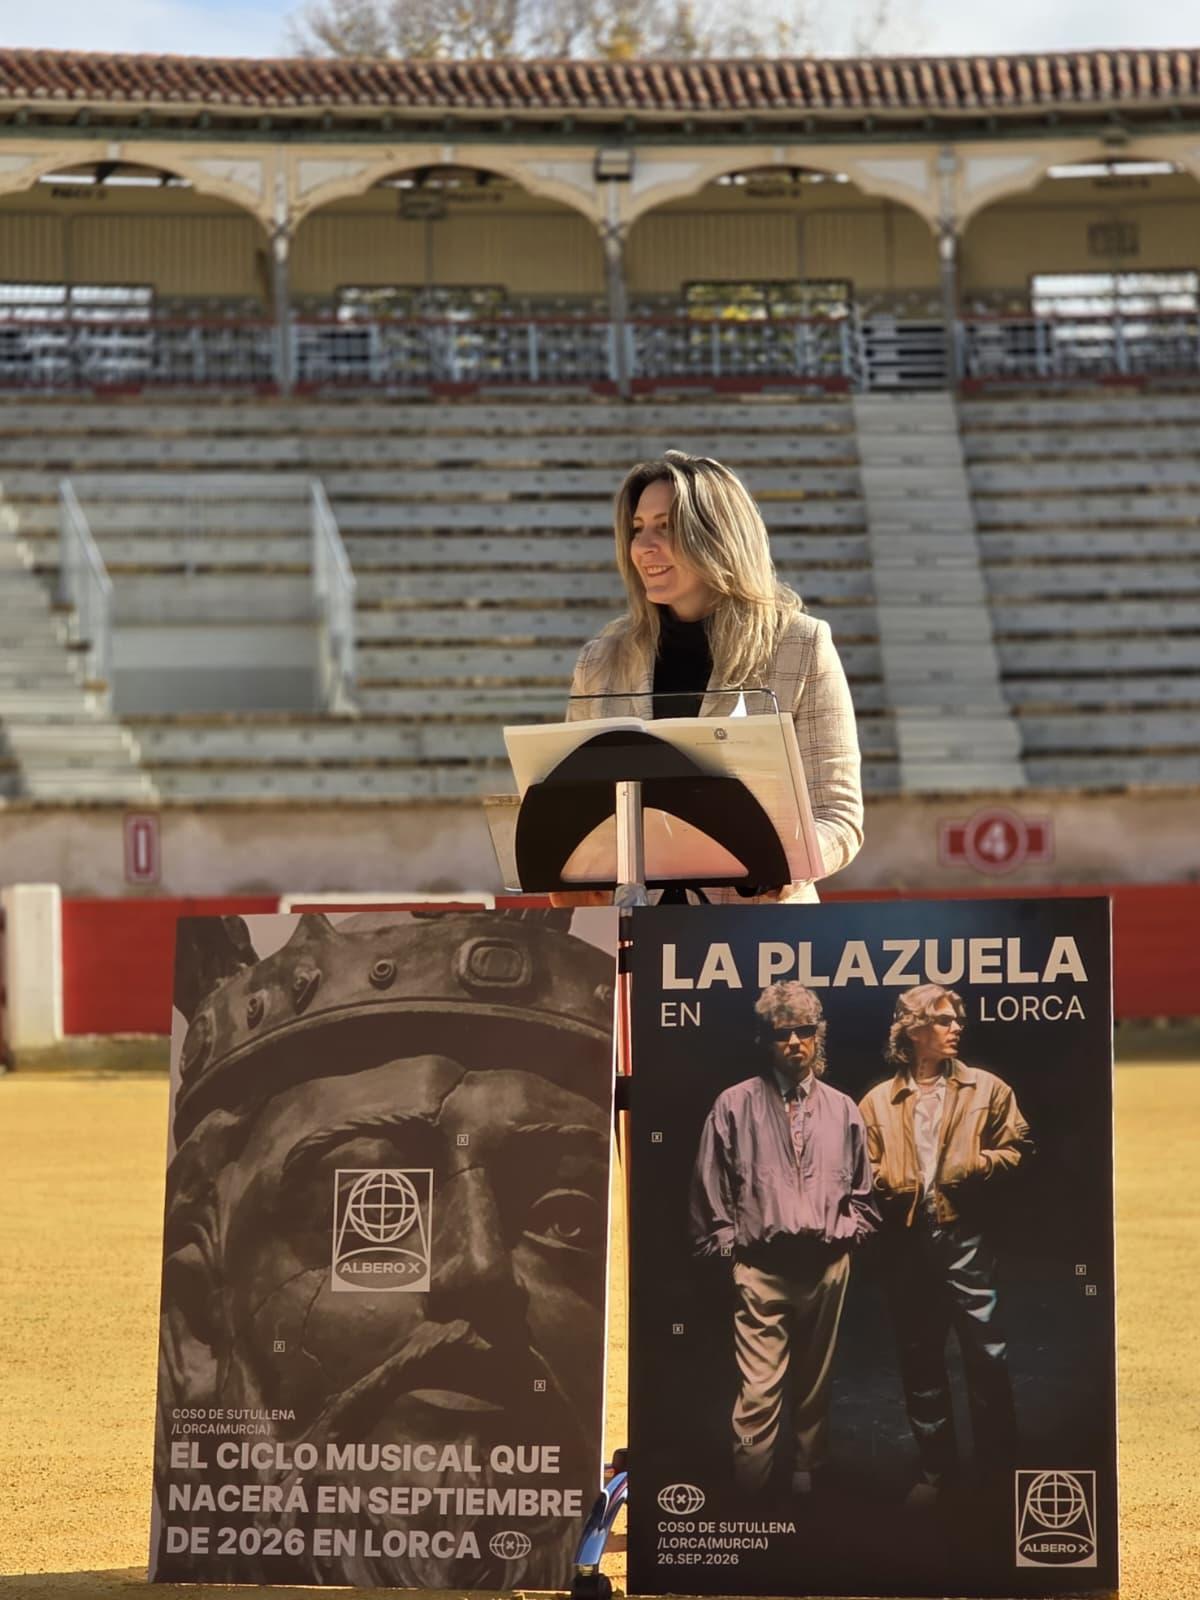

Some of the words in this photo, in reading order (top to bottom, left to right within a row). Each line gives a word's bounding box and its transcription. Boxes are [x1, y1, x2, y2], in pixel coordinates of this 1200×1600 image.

[979, 823, 1008, 859] 4
[662, 943, 742, 990] LA
[758, 936, 1088, 988] PLAZUELA
[661, 1002, 701, 1027] EN
[980, 994, 1085, 1022] LORCA
[340, 1262, 405, 1273] ALBERO
[408, 1262, 420, 1273] X
[172, 1408, 207, 1420] COSO
[209, 1409, 225, 1420] DE
[226, 1408, 295, 1421] SUTULLENA
[171, 1423, 270, 1436] /LORCA(MURCIA)
[170, 1442, 209, 1469] EL
[216, 1443, 318, 1470] CICLO
[326, 1444, 481, 1472] MUSICAL
[490, 1445, 560, 1474] QUE
[168, 1477, 309, 1513] NACERÁ
[317, 1487, 360, 1513] EN
[368, 1487, 582, 1517] SEPTIEMBRE
[658, 1521, 694, 1534] COSO
[698, 1522, 716, 1534] DE
[719, 1522, 796, 1535] SUTULLENA
[167, 1527, 209, 1554] DE
[217, 1527, 304, 1556] 2026
[313, 1529, 355, 1557] EN
[364, 1530, 481, 1559] LORCA
[657, 1537, 768, 1550] /LORCA(MURCIA)
[1024, 1543, 1076, 1553] ALBERO
[1078, 1543, 1089, 1553] X
[657, 1553, 739, 1566] 26.SEP.2026
